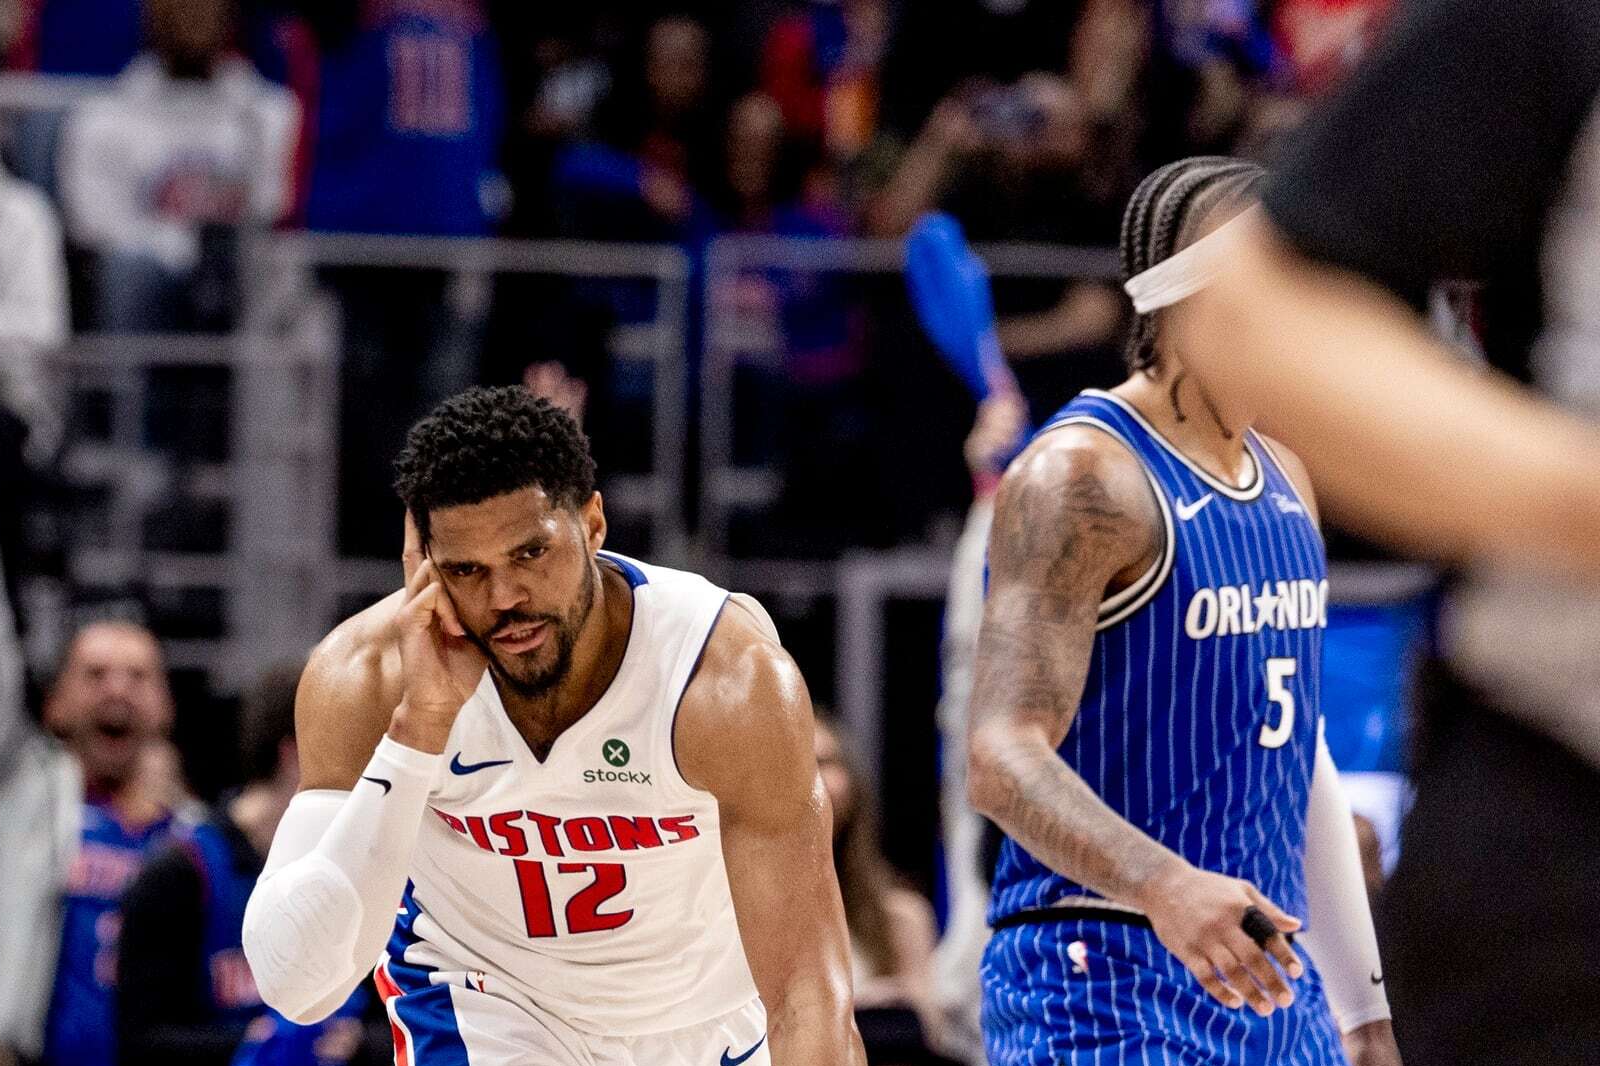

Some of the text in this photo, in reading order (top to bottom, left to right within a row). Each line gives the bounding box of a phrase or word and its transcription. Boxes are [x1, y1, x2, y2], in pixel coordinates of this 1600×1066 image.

[1258, 657, 1297, 749] 5
[583, 768, 652, 786] StockX
[512, 858, 635, 938] 12
